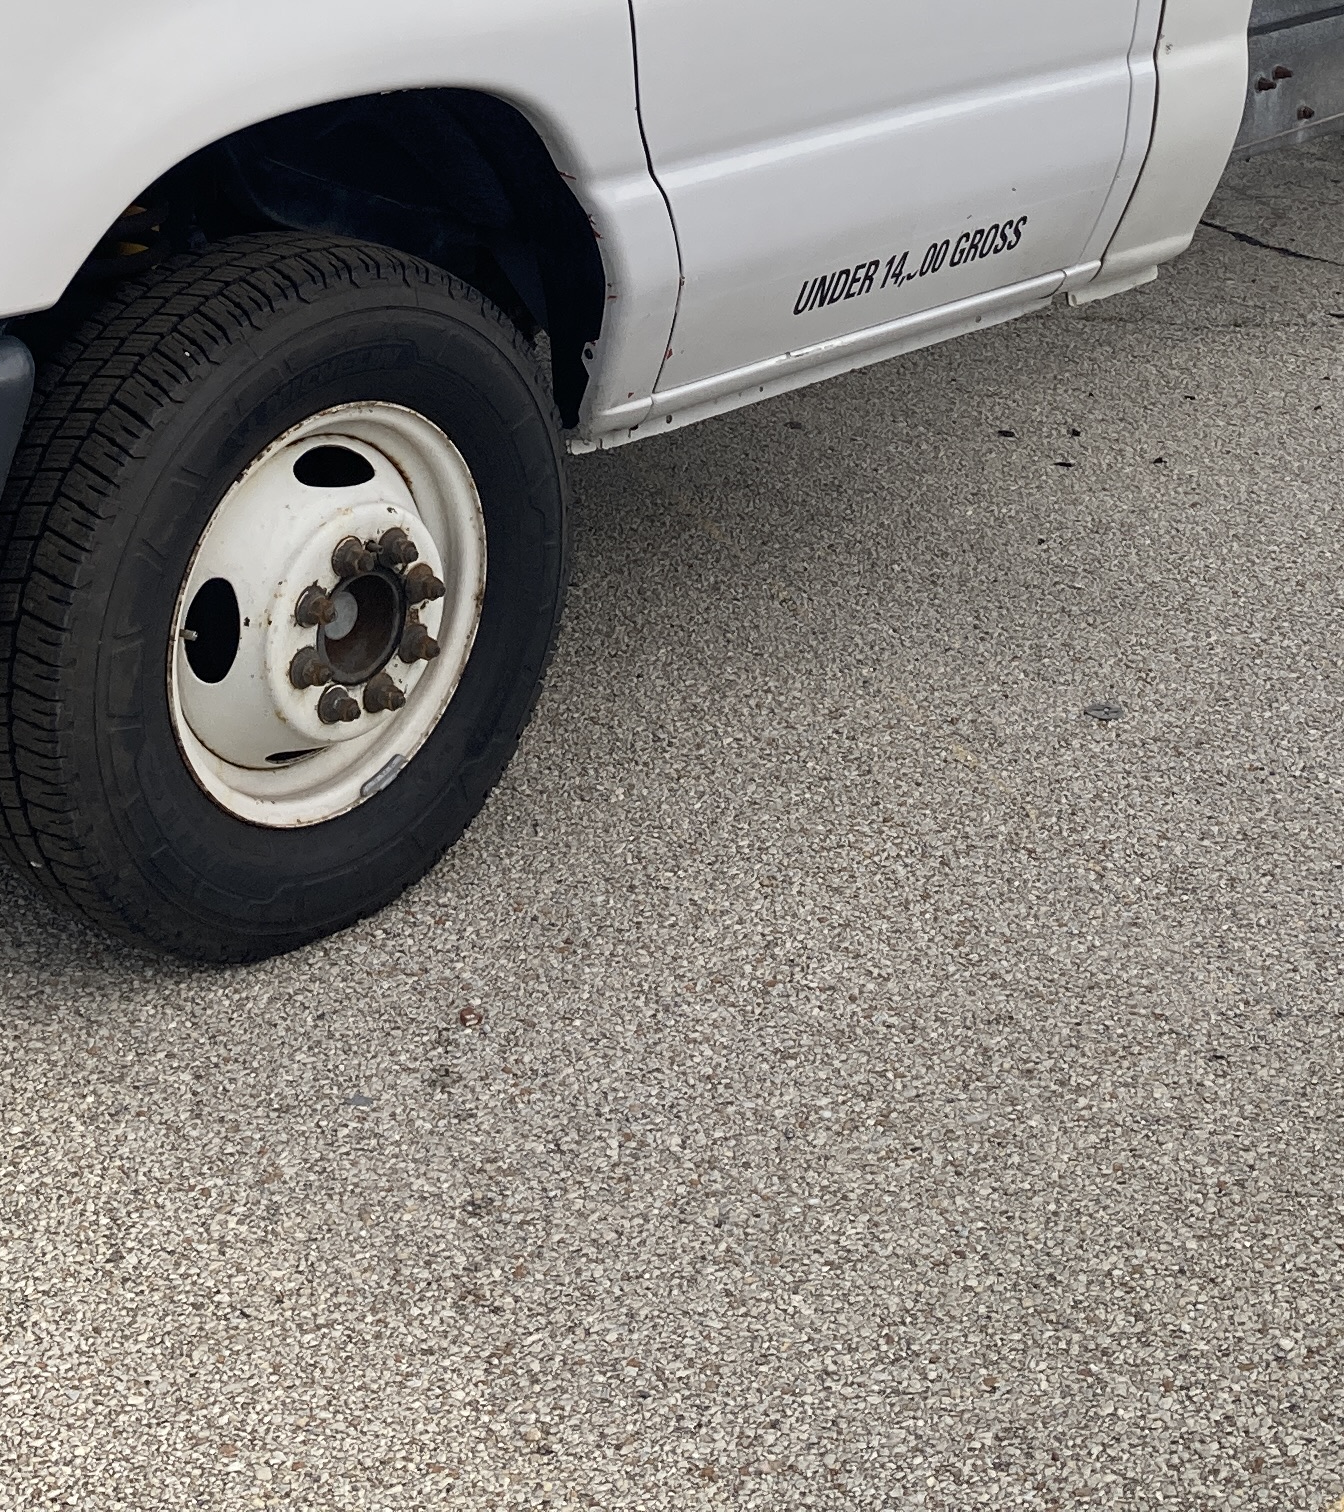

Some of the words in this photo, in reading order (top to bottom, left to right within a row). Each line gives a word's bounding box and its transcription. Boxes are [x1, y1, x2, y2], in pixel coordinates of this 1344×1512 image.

[792, 259, 881, 316] UNDER
[880, 238, 951, 289] 14,00
[949, 215, 1029, 268] GROSS
